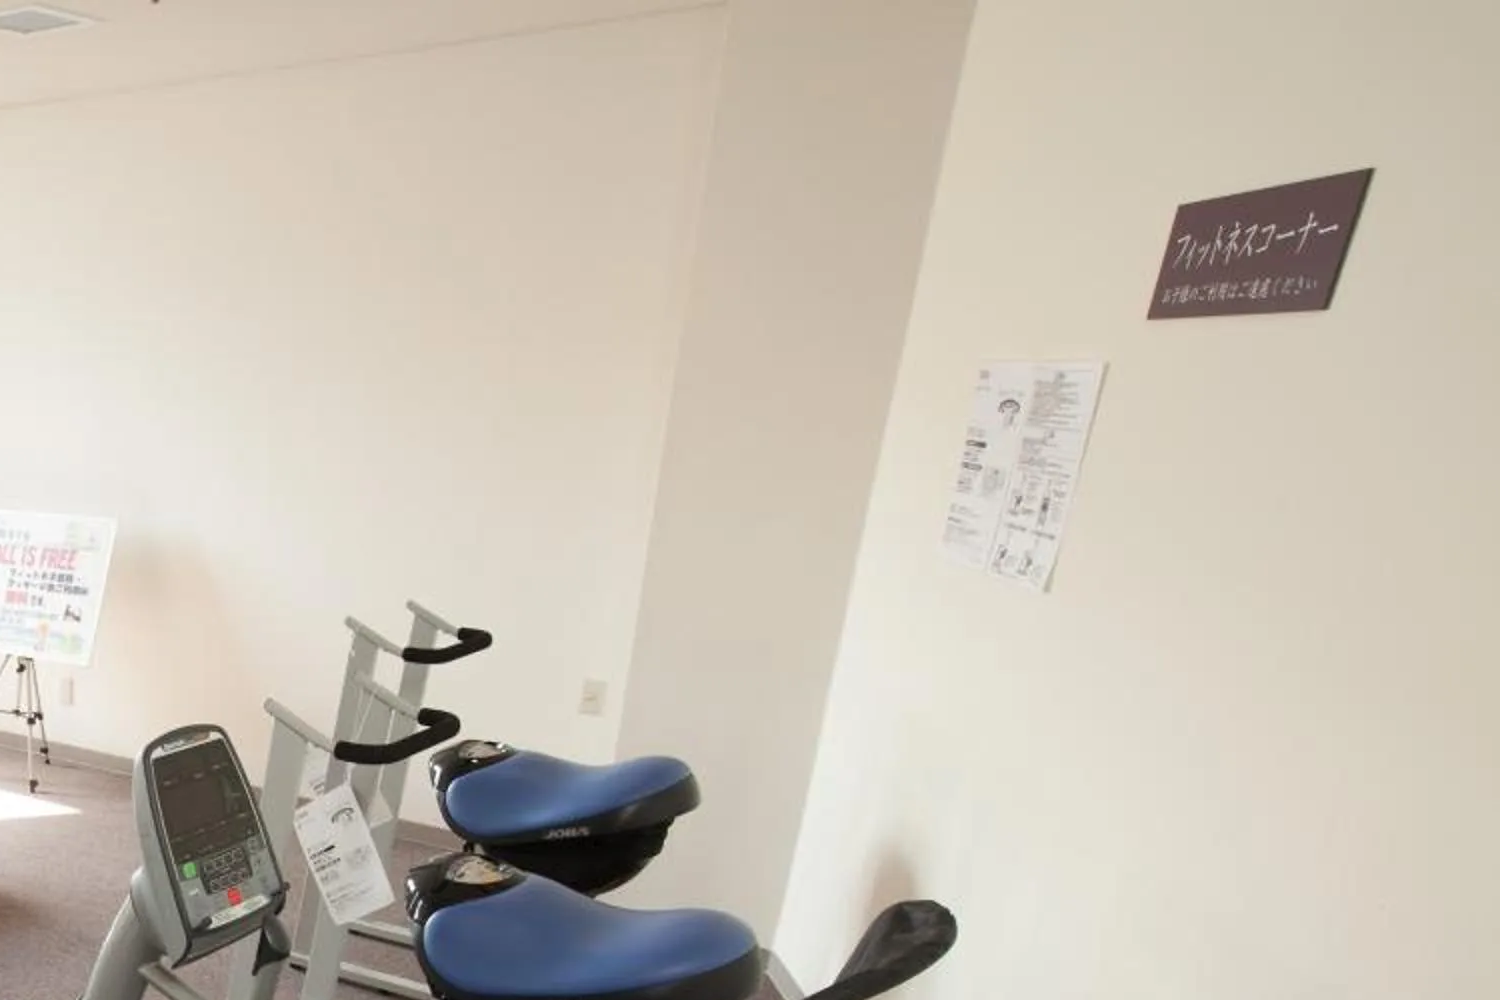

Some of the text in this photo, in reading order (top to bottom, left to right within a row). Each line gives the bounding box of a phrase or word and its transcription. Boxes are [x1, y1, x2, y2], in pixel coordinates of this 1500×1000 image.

[1171, 211, 1340, 270] フィットネスコーナー
[20, 546, 38, 568] IS
[39, 548, 79, 571] FREE
